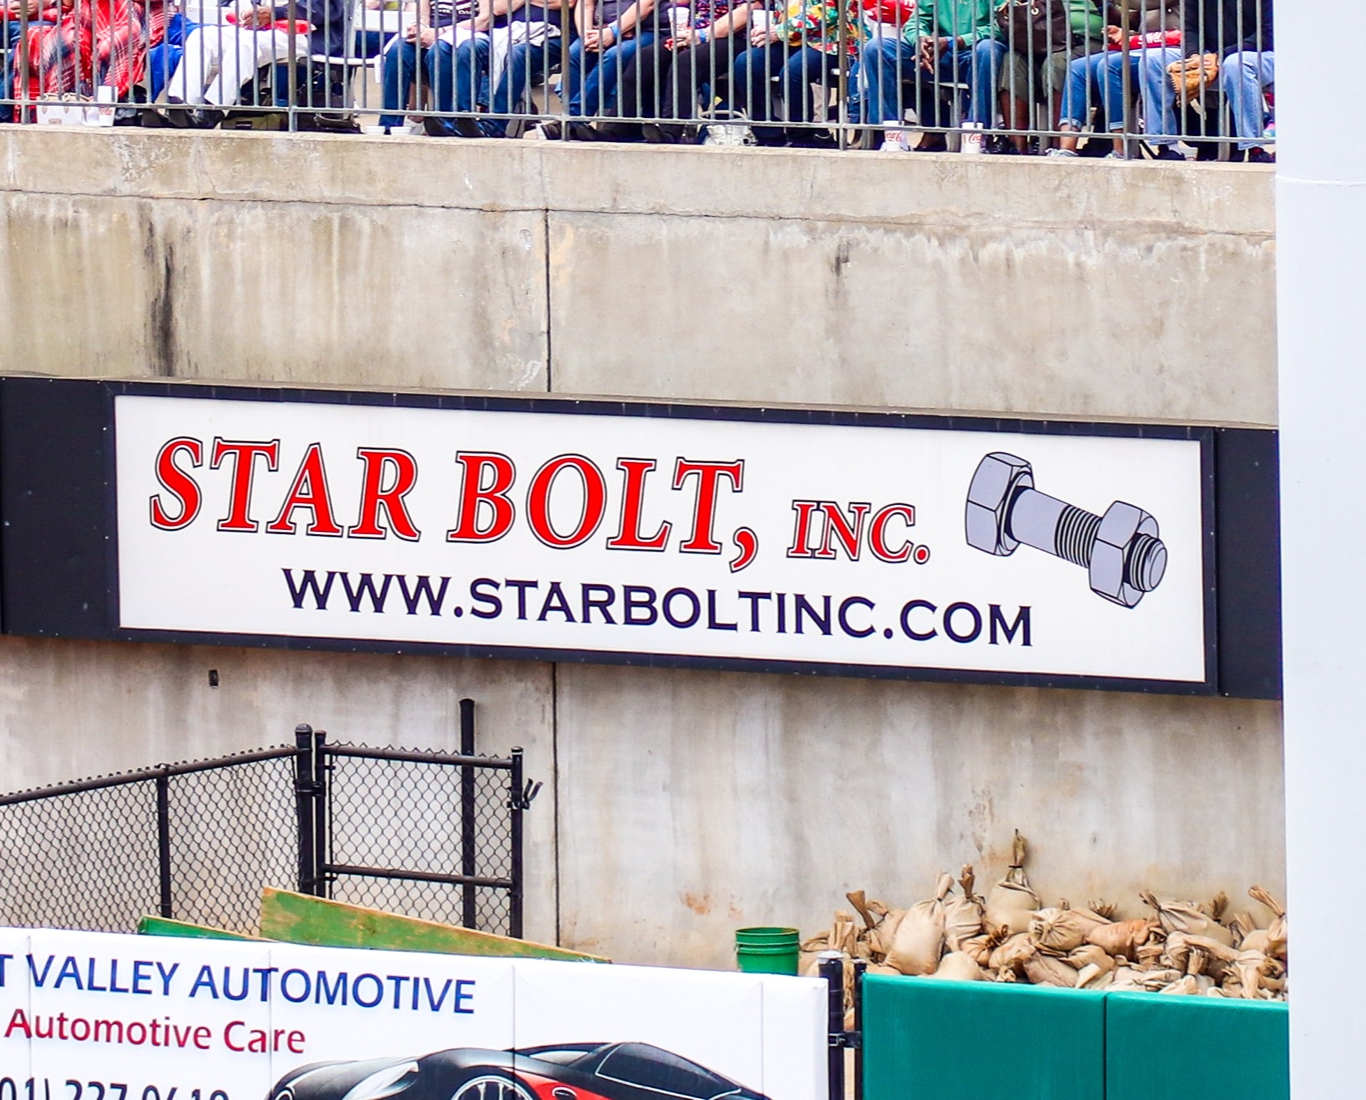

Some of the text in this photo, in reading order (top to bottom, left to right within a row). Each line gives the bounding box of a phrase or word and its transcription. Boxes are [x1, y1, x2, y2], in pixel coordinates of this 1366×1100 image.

[148, 436, 932, 573] STAR BOLT, INC.
[281, 566, 1034, 648] WWW.STARBOLTINC.COM
[25, 952, 182, 998] VALLEY
[188, 961, 477, 1015] AUTOMOTIVE
[4, 1008, 212, 1050] Automotive
[223, 1020, 307, 1055] Care
